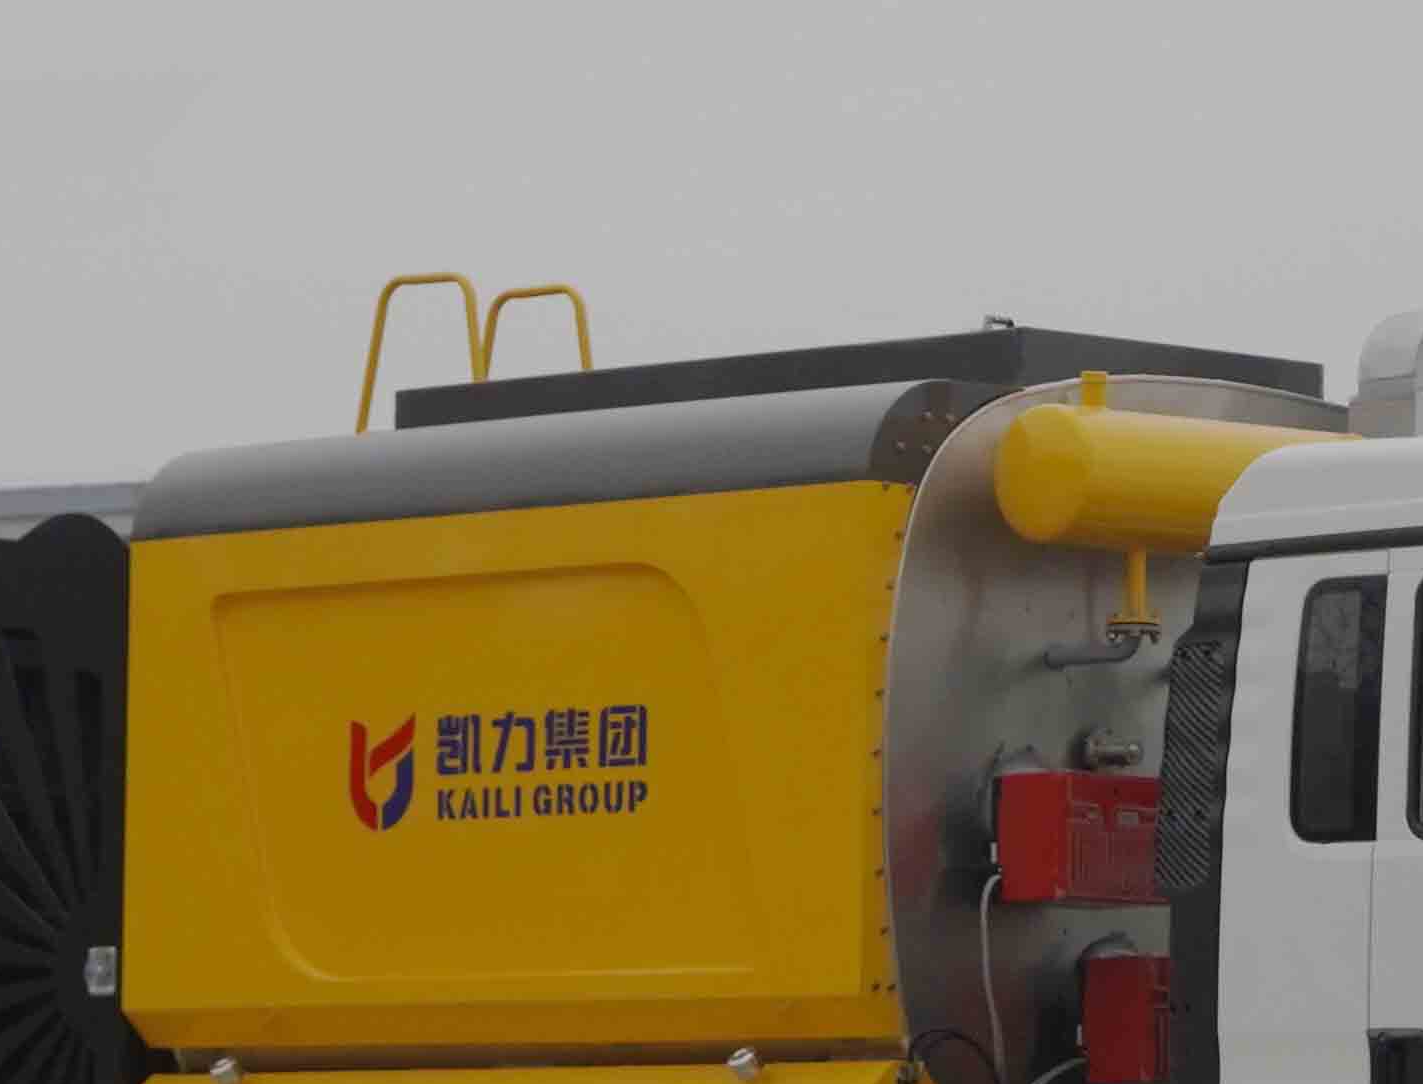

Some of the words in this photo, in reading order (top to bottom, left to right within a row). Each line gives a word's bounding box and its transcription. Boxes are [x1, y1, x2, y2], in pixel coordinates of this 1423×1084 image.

[436, 704, 648, 776] 凯力集团
[436, 785, 522, 821] KAILI
[532, 780, 649, 817] GROUP
